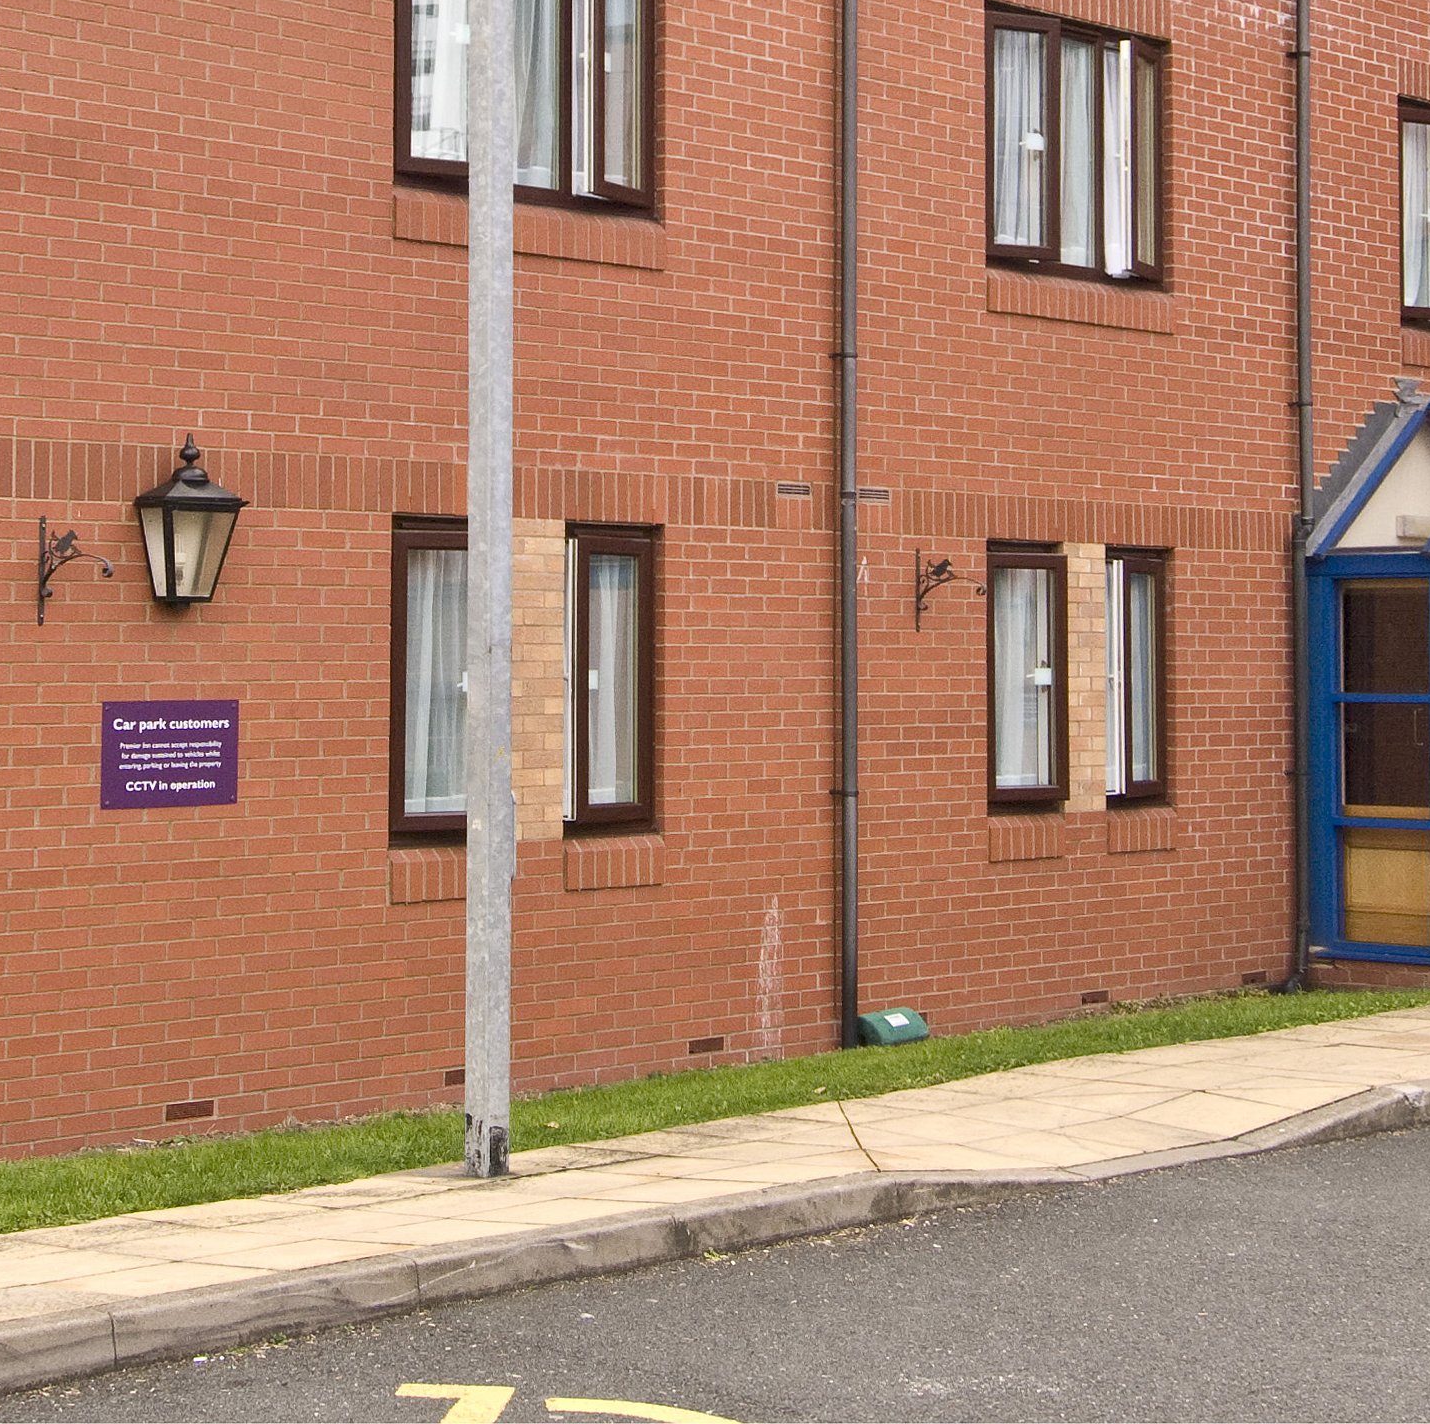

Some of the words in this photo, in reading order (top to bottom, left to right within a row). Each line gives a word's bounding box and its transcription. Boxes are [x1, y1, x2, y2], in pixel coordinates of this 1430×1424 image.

[112, 718, 137, 731] Car
[138, 717, 167, 734] park
[169, 719, 230, 730] customers
[125, 780, 157, 792] CCTV
[158, 780, 168, 791] in
[170, 779, 216, 793] operation
